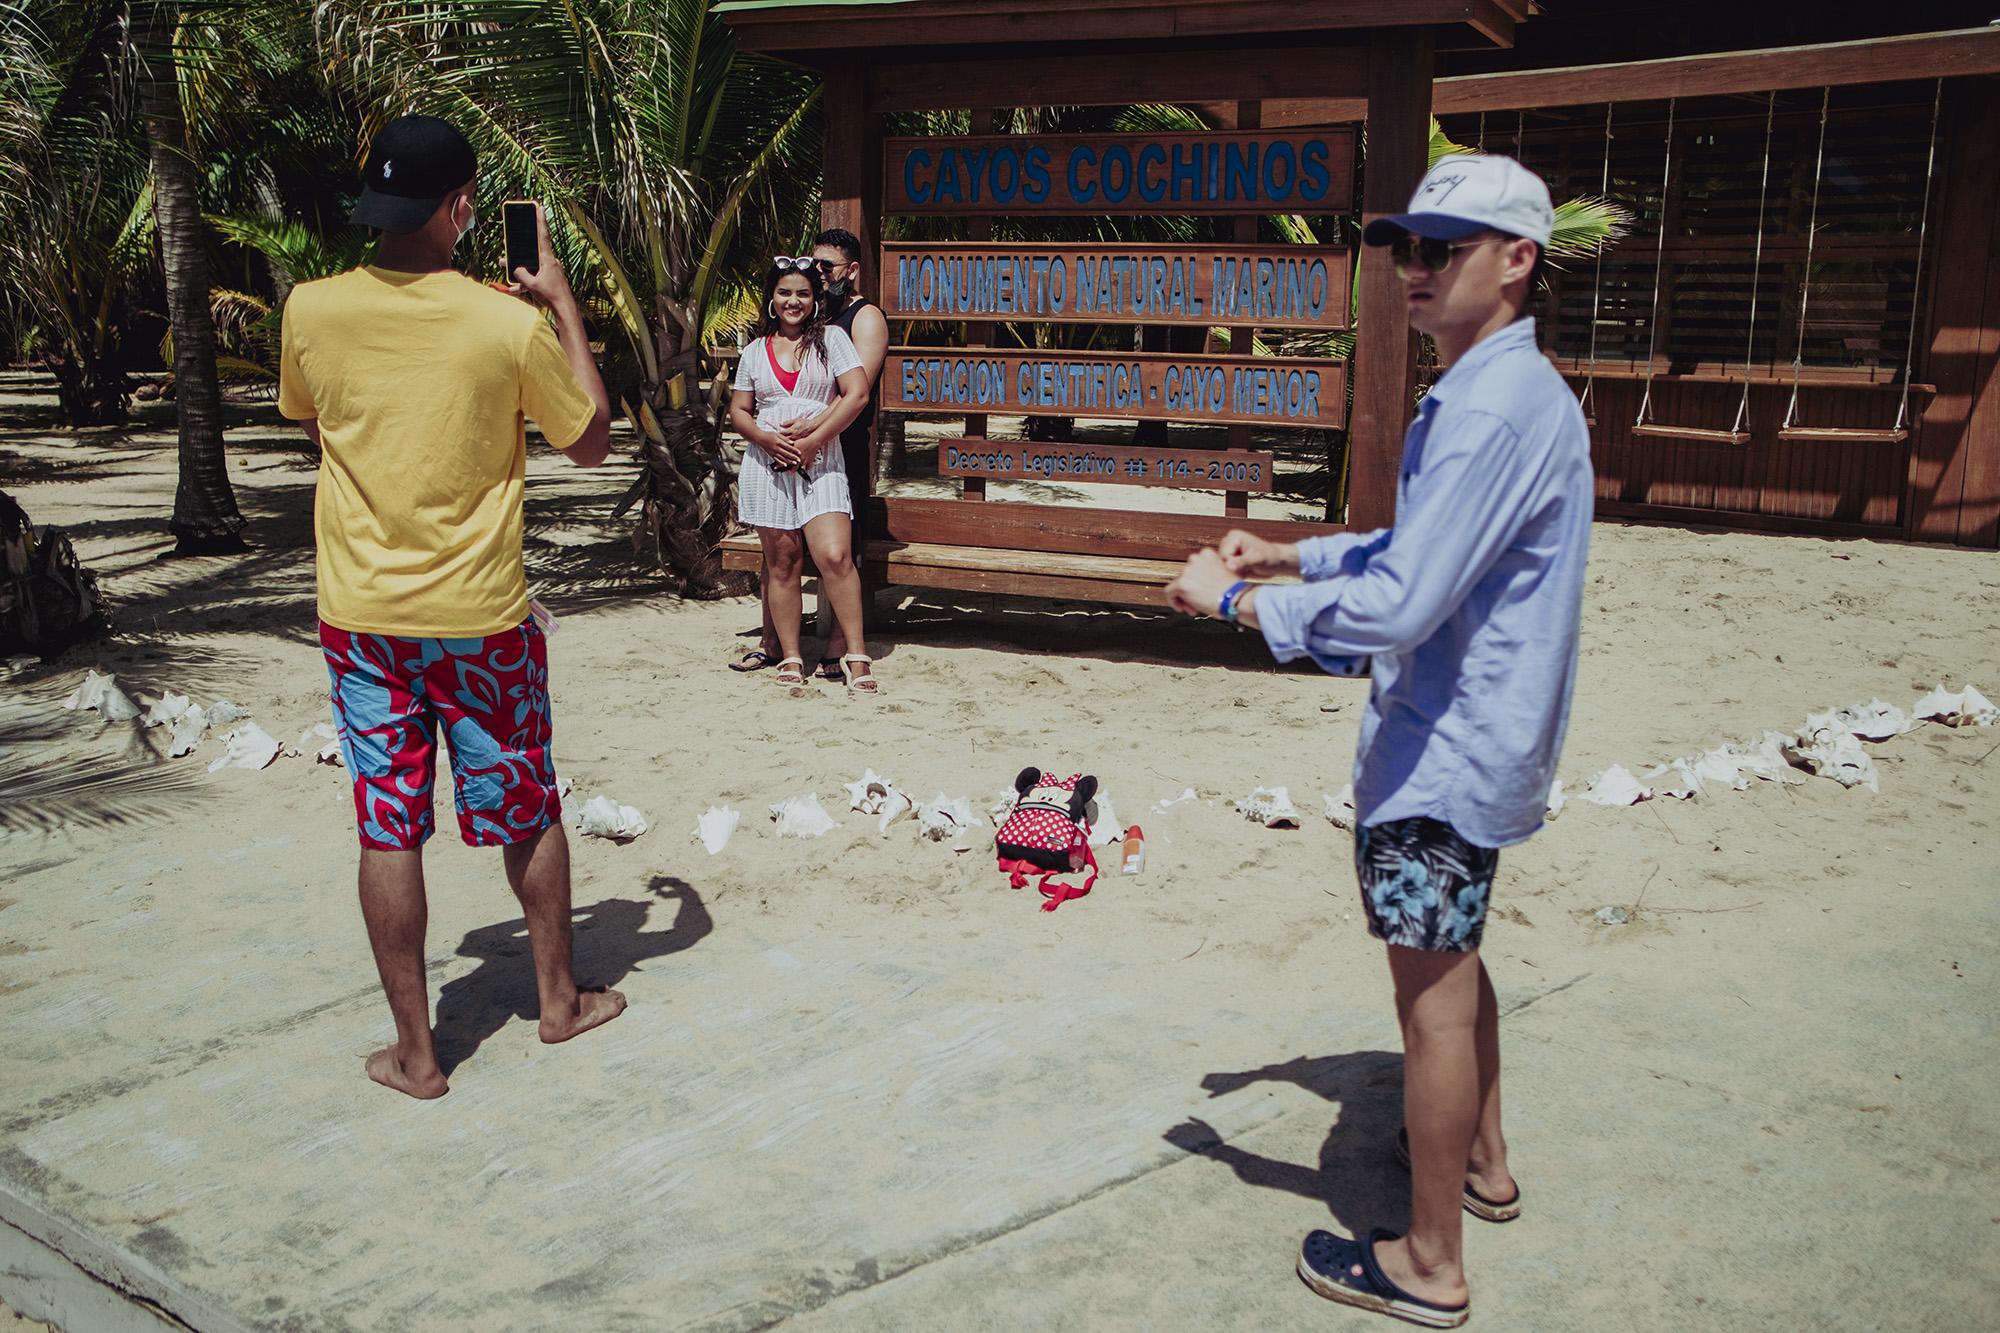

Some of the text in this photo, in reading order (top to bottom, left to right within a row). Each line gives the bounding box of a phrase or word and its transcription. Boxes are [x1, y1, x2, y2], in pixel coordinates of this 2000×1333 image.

[904, 139, 1330, 204] CAYOS COCHINOS
[898, 255, 1328, 320] MONUMENTO NATURAL MARINO
[902, 358, 1006, 405] ESTACION
[1017, 361, 1144, 408] CIENTIFICA
[1164, 364, 1226, 414] CAYO
[1232, 367, 1322, 418] MENOR
[947, 447, 1014, 471] Decreto
[1023, 450, 1116, 478] Legislativo
